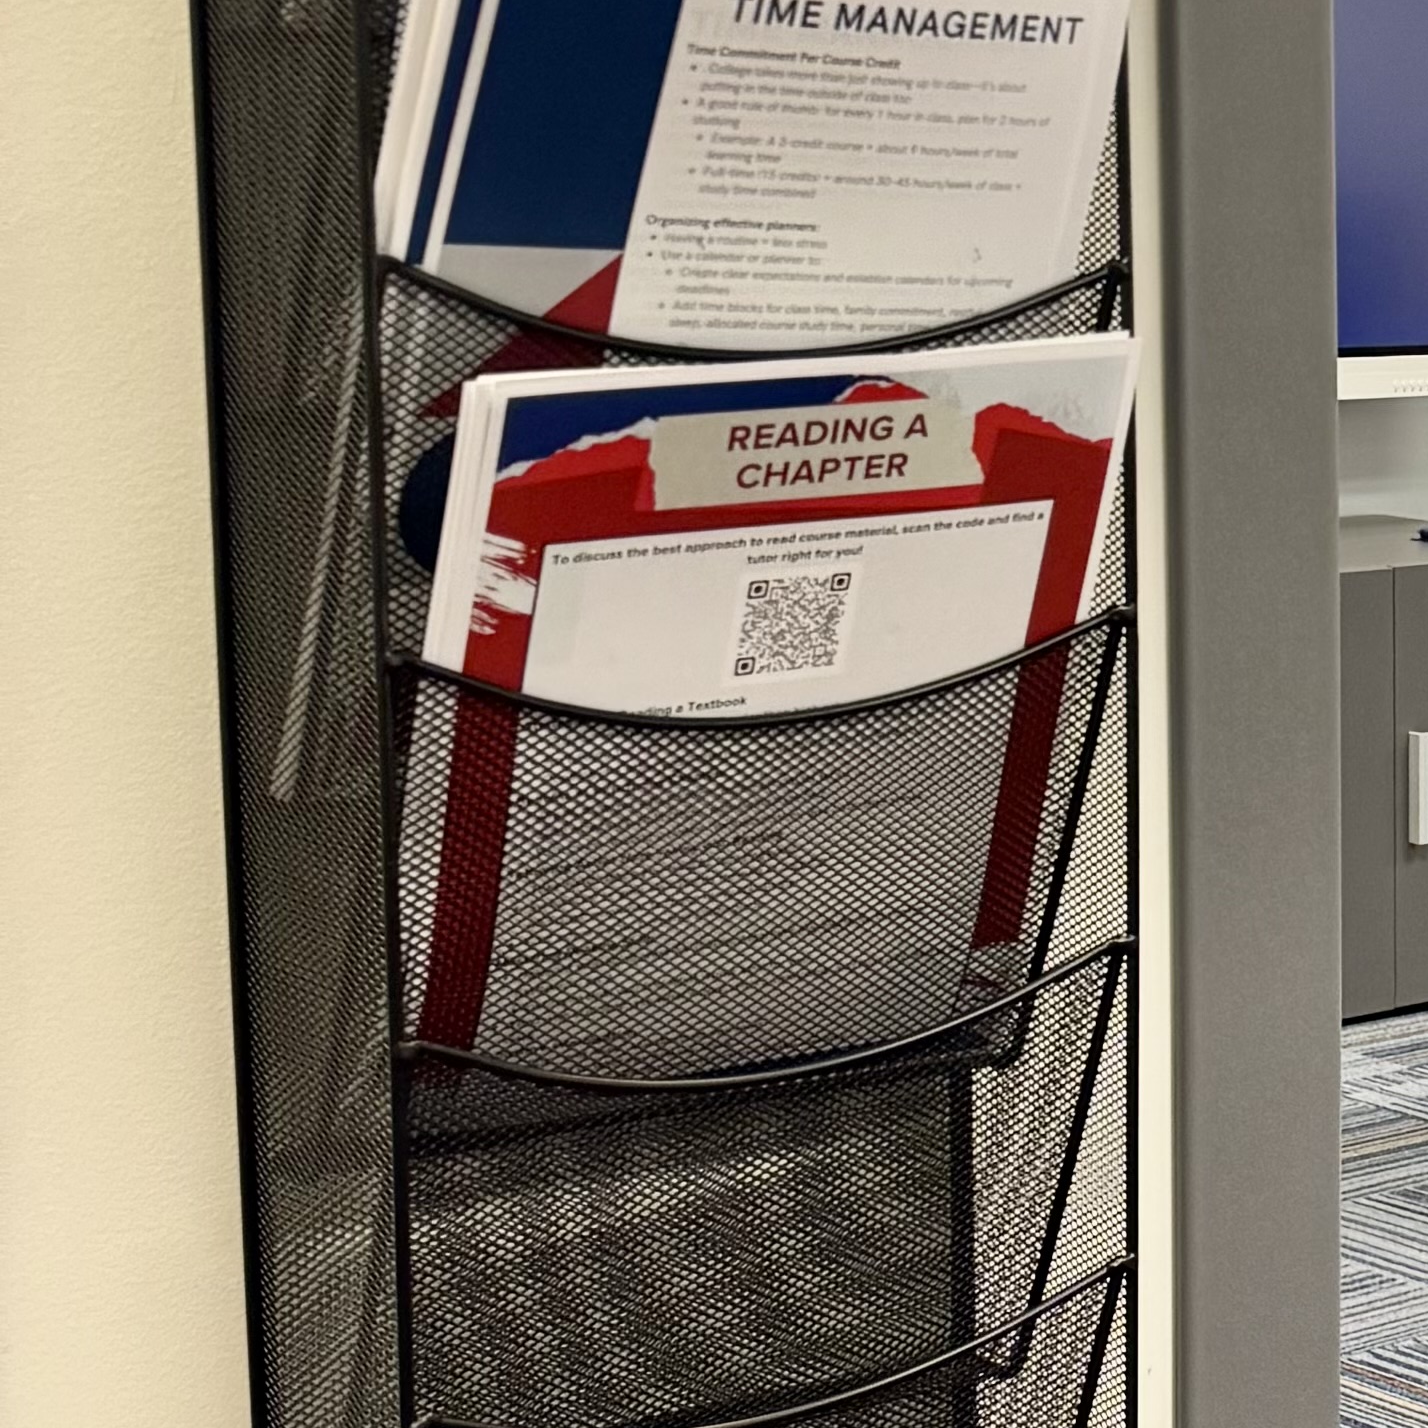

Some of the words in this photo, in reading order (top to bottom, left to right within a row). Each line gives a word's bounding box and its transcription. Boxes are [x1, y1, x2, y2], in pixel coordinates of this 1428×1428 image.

[832, 1, 1086, 44] MANAGEMENT
[685, 44, 716, 56] Time
[718, 46, 797, 61] Commitment
[799, 51, 820, 63] Per
[821, 53, 863, 66] Course
[864, 56, 901, 68] Credit
[726, 412, 895, 454] READING
[904, 409, 931, 439] A
[736, 451, 909, 491] CHAPTER
[551, 554, 569, 565] To
[573, 551, 622, 563] discuss
[626, 547, 648, 558] the
[652, 543, 682, 555] best
[685, 537, 747, 554] approach
[750, 536, 763, 546] to
[766, 532, 796, 545] read
[799, 531, 841, 542] course
[902, 522, 931, 532] scan
[933, 518, 952, 529] the
[955, 515, 985, 527] code
[987, 512, 1010, 524] and
[1012, 510, 1035, 522] find
[1036, 512, 1044, 520] a
[747, 553, 779, 564] tutor
[781, 549, 812, 563] right
[815, 548, 833, 558] for
[835, 544, 863, 559] you!
[675, 704, 683, 713] a
[688, 696, 747, 712] Textbook
